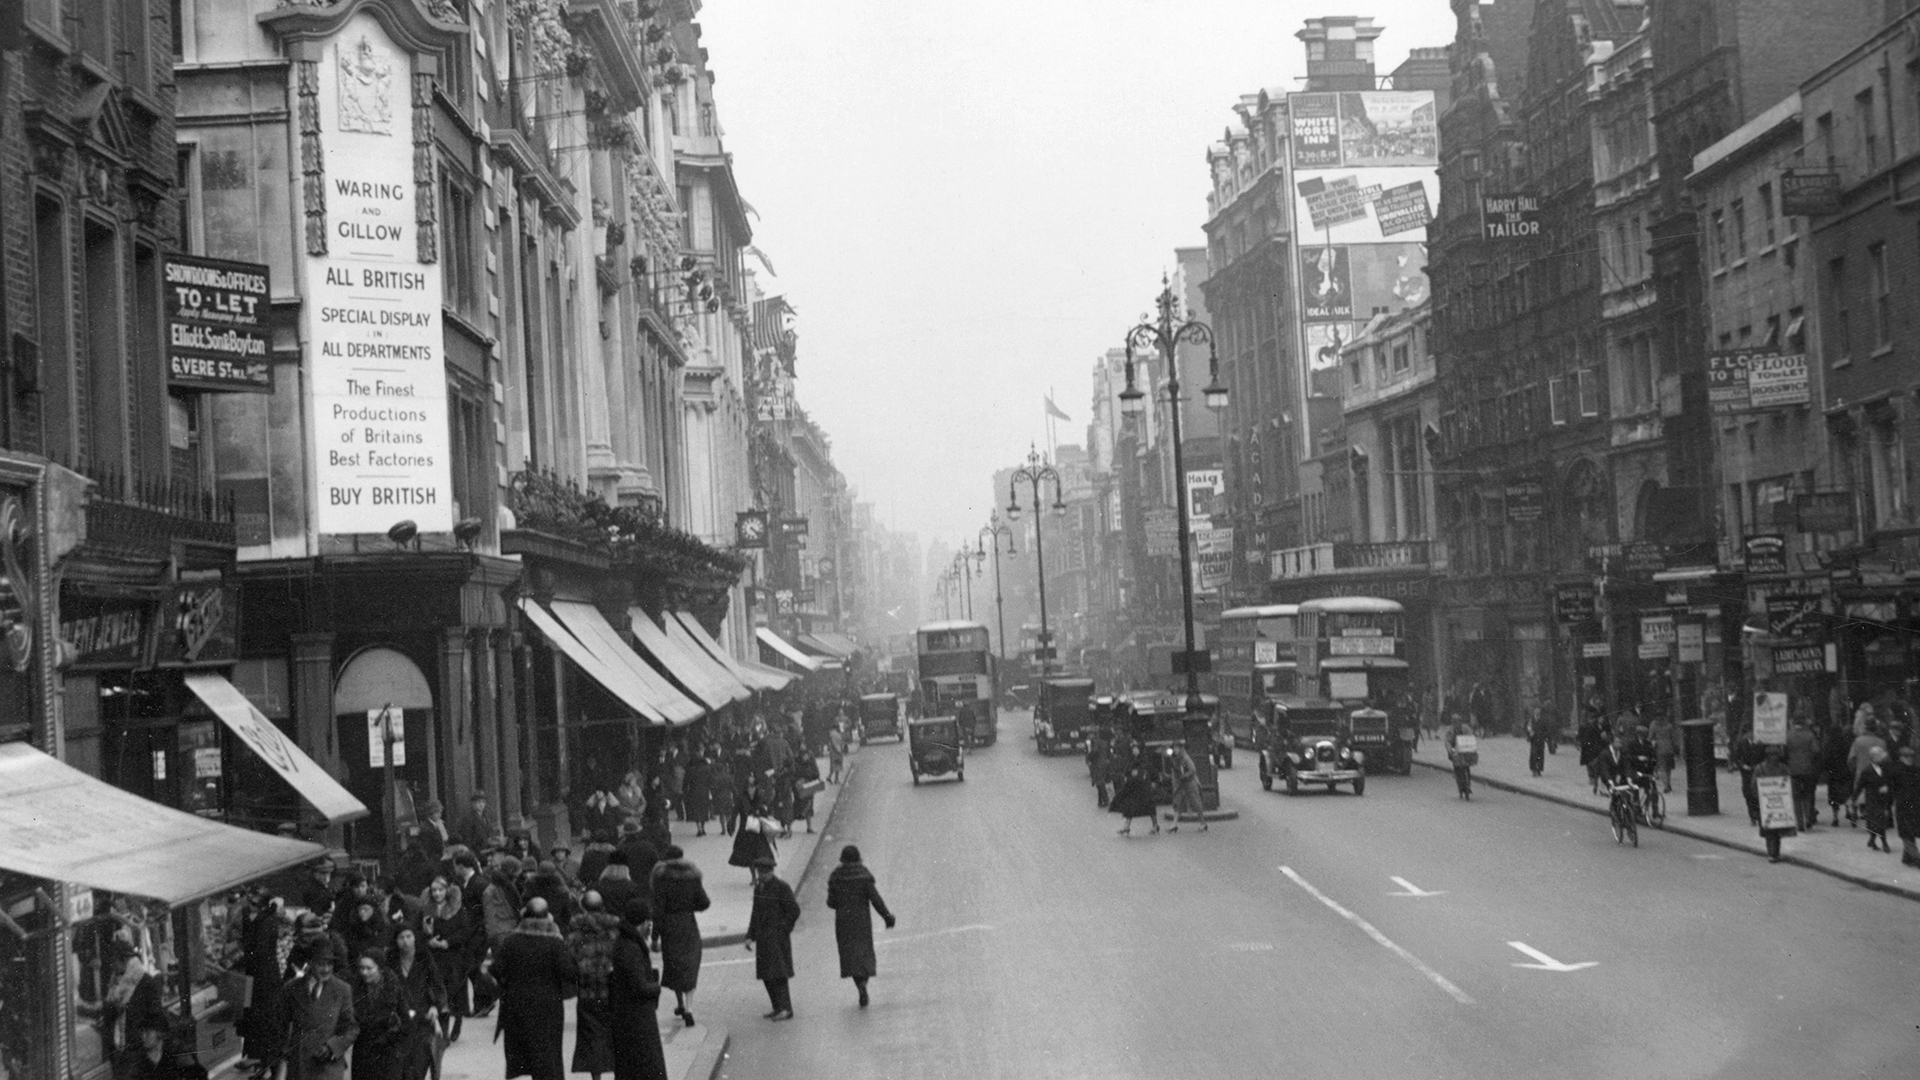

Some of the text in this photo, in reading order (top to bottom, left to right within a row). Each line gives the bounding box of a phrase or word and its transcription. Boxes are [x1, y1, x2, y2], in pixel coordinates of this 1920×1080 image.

[1294, 117, 1336, 127] WHITE
[1295, 126, 1337, 136] HORSE
[1304, 134, 1330, 145] INN
[335, 178, 404, 200] WARING
[1357, 184, 1382, 196] STOLL
[361, 207, 381, 216] AND
[1379, 203, 1425, 222] UNRIVALLED
[1486, 196, 1540, 213] HARRY HALL
[1383, 211, 1428, 228] ACOUSTIC
[1505, 212, 1521, 222] THE
[338, 221, 403, 241] GILLOW
[1384, 219, 1428, 236] PROPERTIES
[1487, 221, 1540, 238] TAILOR
[326, 267, 425, 290] ALL BRITISH
[321, 307, 431, 327] SPECIAL DISPLAY
[1307, 306, 1330, 317] IDEAL
[322, 341, 431, 360] ALL DEPARTMENTS
[1708, 369, 1728, 382] TO
[1757, 371, 1772, 380] TO
[1782, 368, 1805, 377] LET
[346, 379, 415, 397] The Finest
[333, 404, 427, 422] Productions
[341, 427, 423, 444] of Britains
[329, 450, 434, 467] Best Factories
[1188, 474, 1218, 486] Haig
[330, 487, 436, 506] BUY BRITISH
[1250, 432, 1266, 565] ACADEMY
[1202, 563, 1231, 576] SCHAFT
